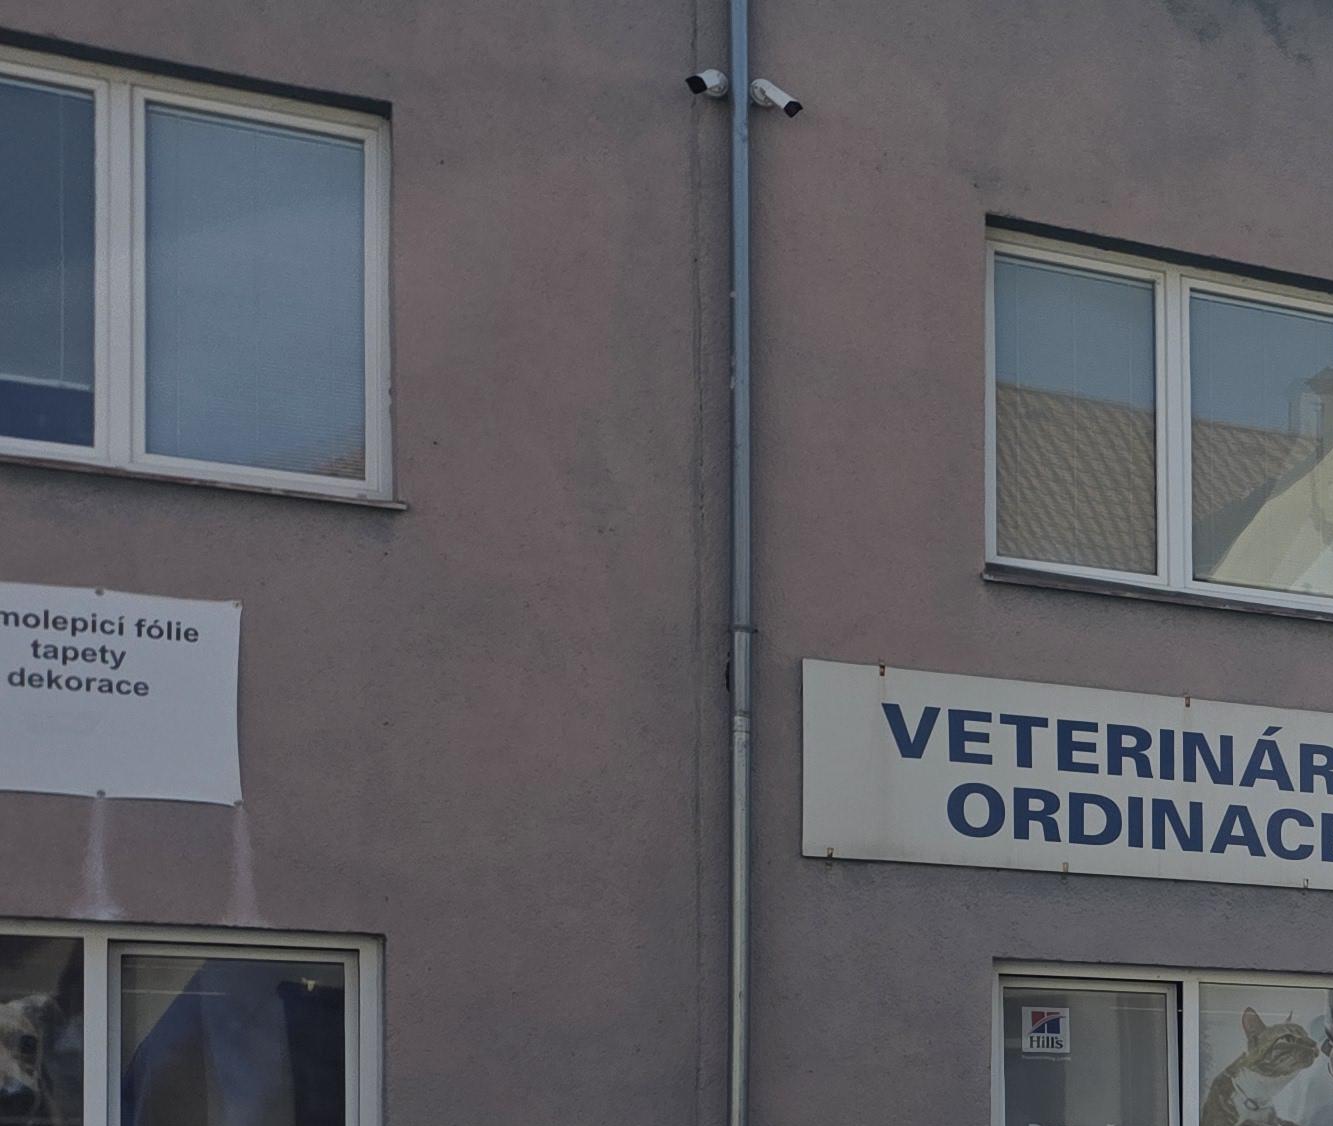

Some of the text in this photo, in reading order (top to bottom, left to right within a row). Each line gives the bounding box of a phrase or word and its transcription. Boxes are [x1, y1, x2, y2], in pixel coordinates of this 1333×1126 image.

[0, 608, 200, 643] molepicí fólie
[30, 638, 127, 670] tapety
[7, 667, 150, 697] dekorace
